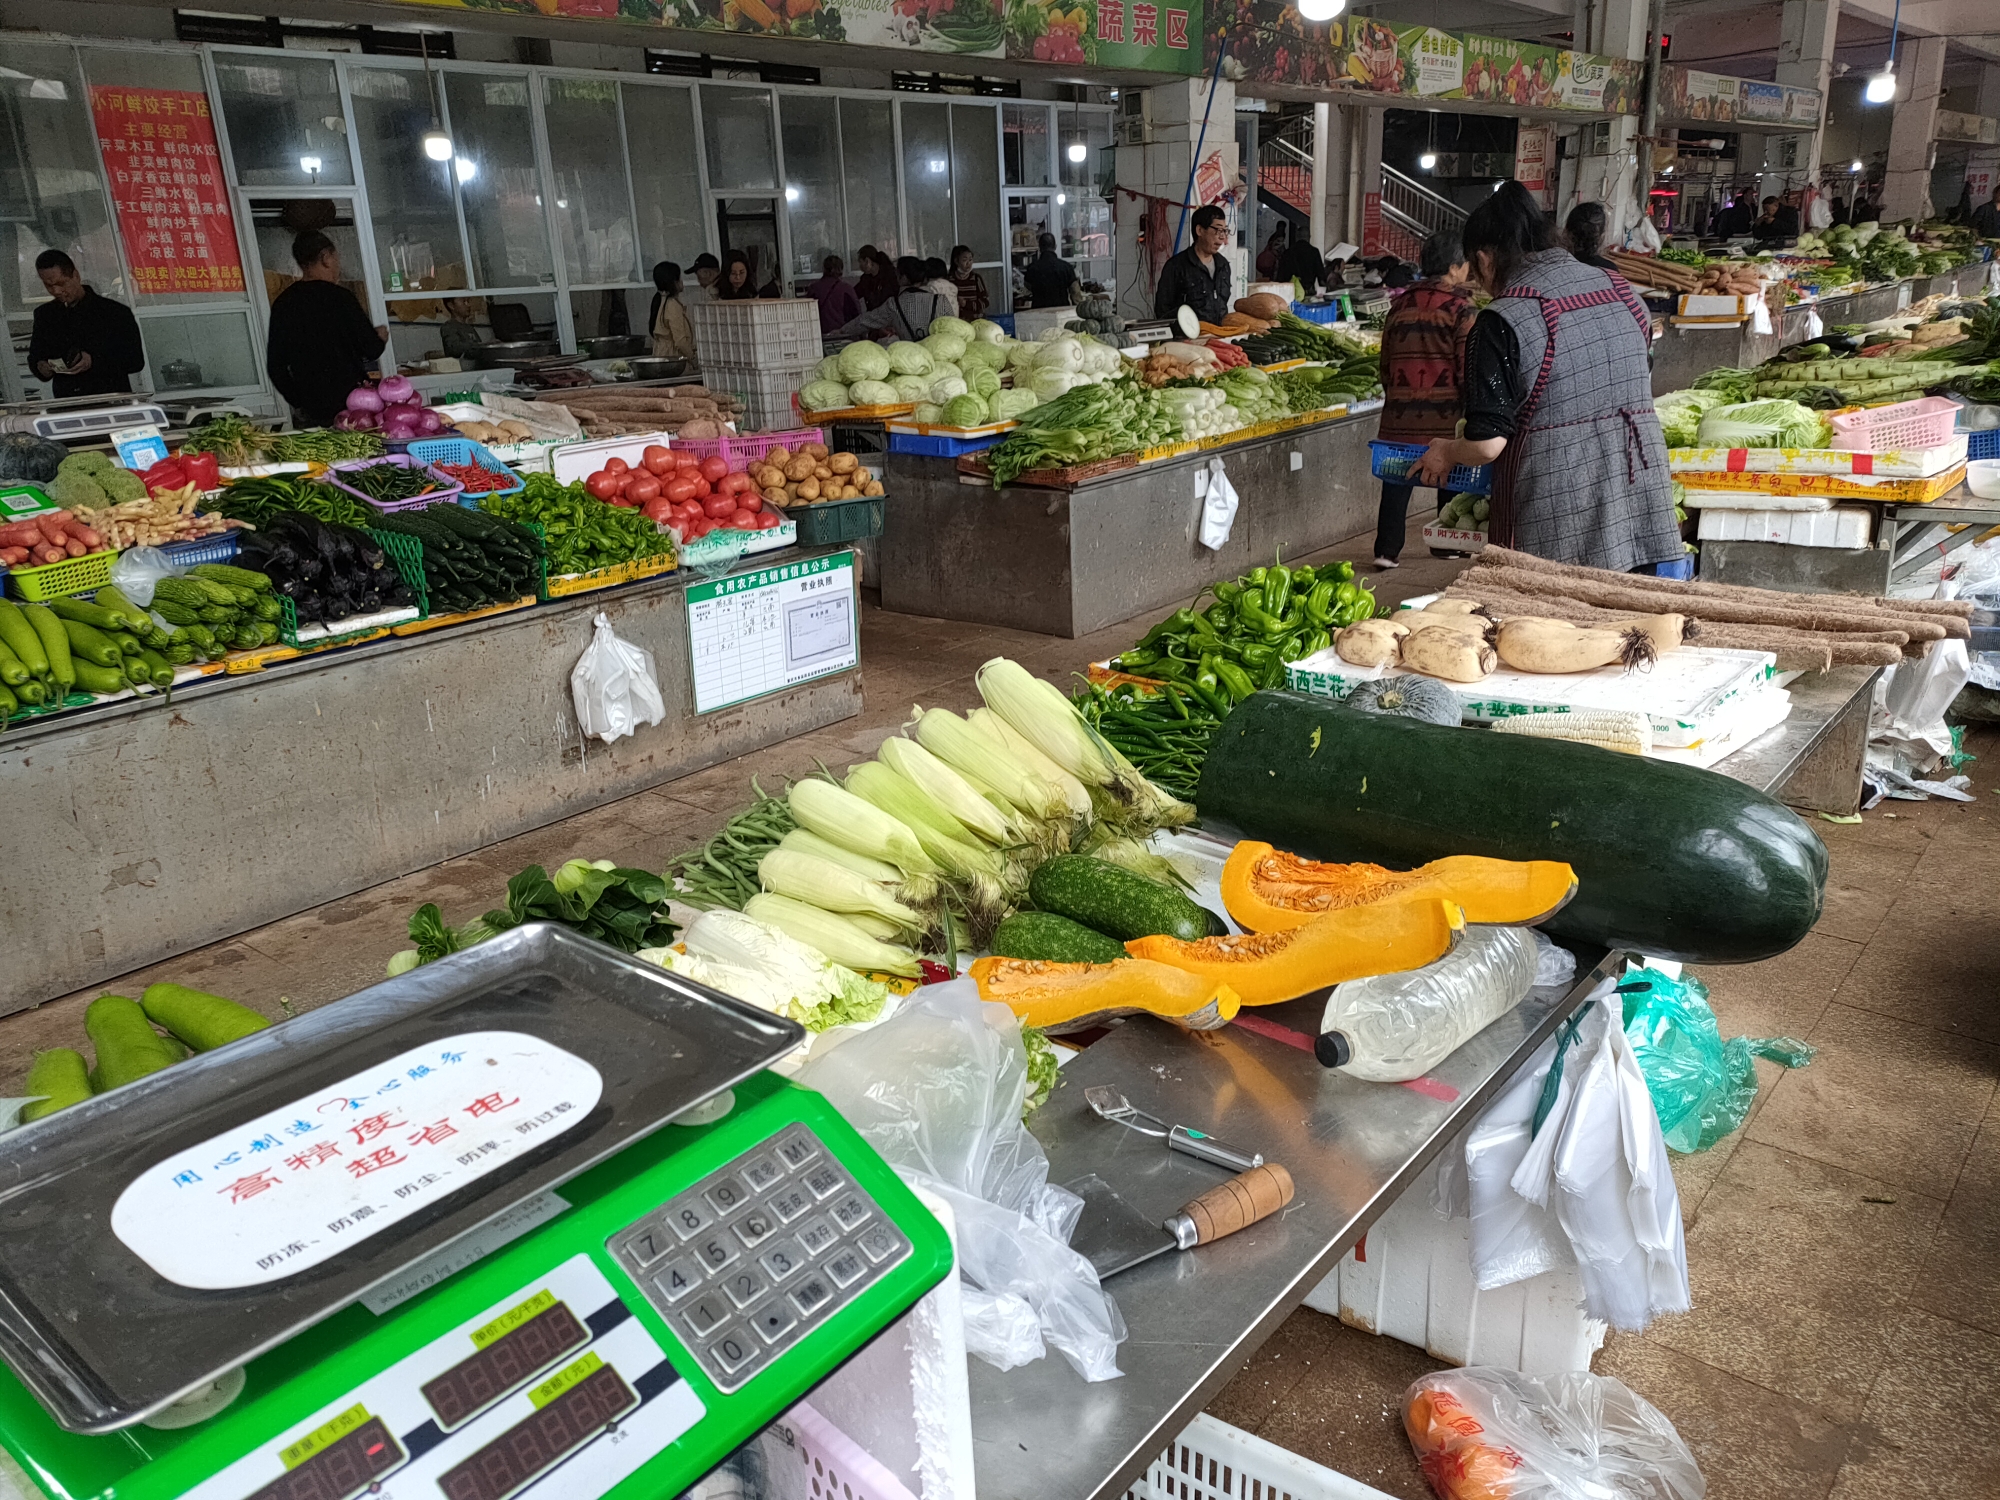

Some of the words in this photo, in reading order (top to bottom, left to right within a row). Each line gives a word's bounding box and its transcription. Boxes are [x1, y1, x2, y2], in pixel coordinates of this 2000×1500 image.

[1097, 0, 1189, 49] 蔬菜区
[124, 122, 188, 140] 主要经营
[99, 138, 156, 153] 芹菜木耳
[163, 141, 218, 157] 鲜肉水饺
[128, 155, 196, 171] 韭菜鲜肉饺
[116, 170, 213, 186] 白菜香菇鲜肉饺
[141, 186, 197, 201] 三鲜水饺
[146, 216, 201, 230] 鲜肉抄手
[146, 231, 173, 244] 米线
[181, 232, 206, 245] 河粉
[150, 246, 176, 260] 凉皮
[183, 246, 209, 260] 凉面
[714, 558, 830, 597] 食用农产品销售信息公示
[800, 575, 834, 593] 营业执照
[172, 1118, 324, 1189] 用心制造
[344, 1050, 468, 1111] 全心服务
[344, 1092, 520, 1179] 超省电
[216, 1110, 410, 1204] 高精度
[640, 1235, 655, 1256] 7
[681, 1209, 700, 1229] 8
[718, 1187, 736, 1207] 9
[784, 1140, 811, 1163] M1
[672, 1269, 687, 1289] 4
[708, 1242, 727, 1263] 5
[746, 1216, 766, 1237] 6
[778, 1191, 804, 1216] 去皮
[810, 1170, 839, 1192] 电压
[699, 1304, 715, 1323] 1
[738, 1275, 759, 1297] 2
[773, 1253, 792, 1273] 3
[723, 1340, 743, 1361] 0
